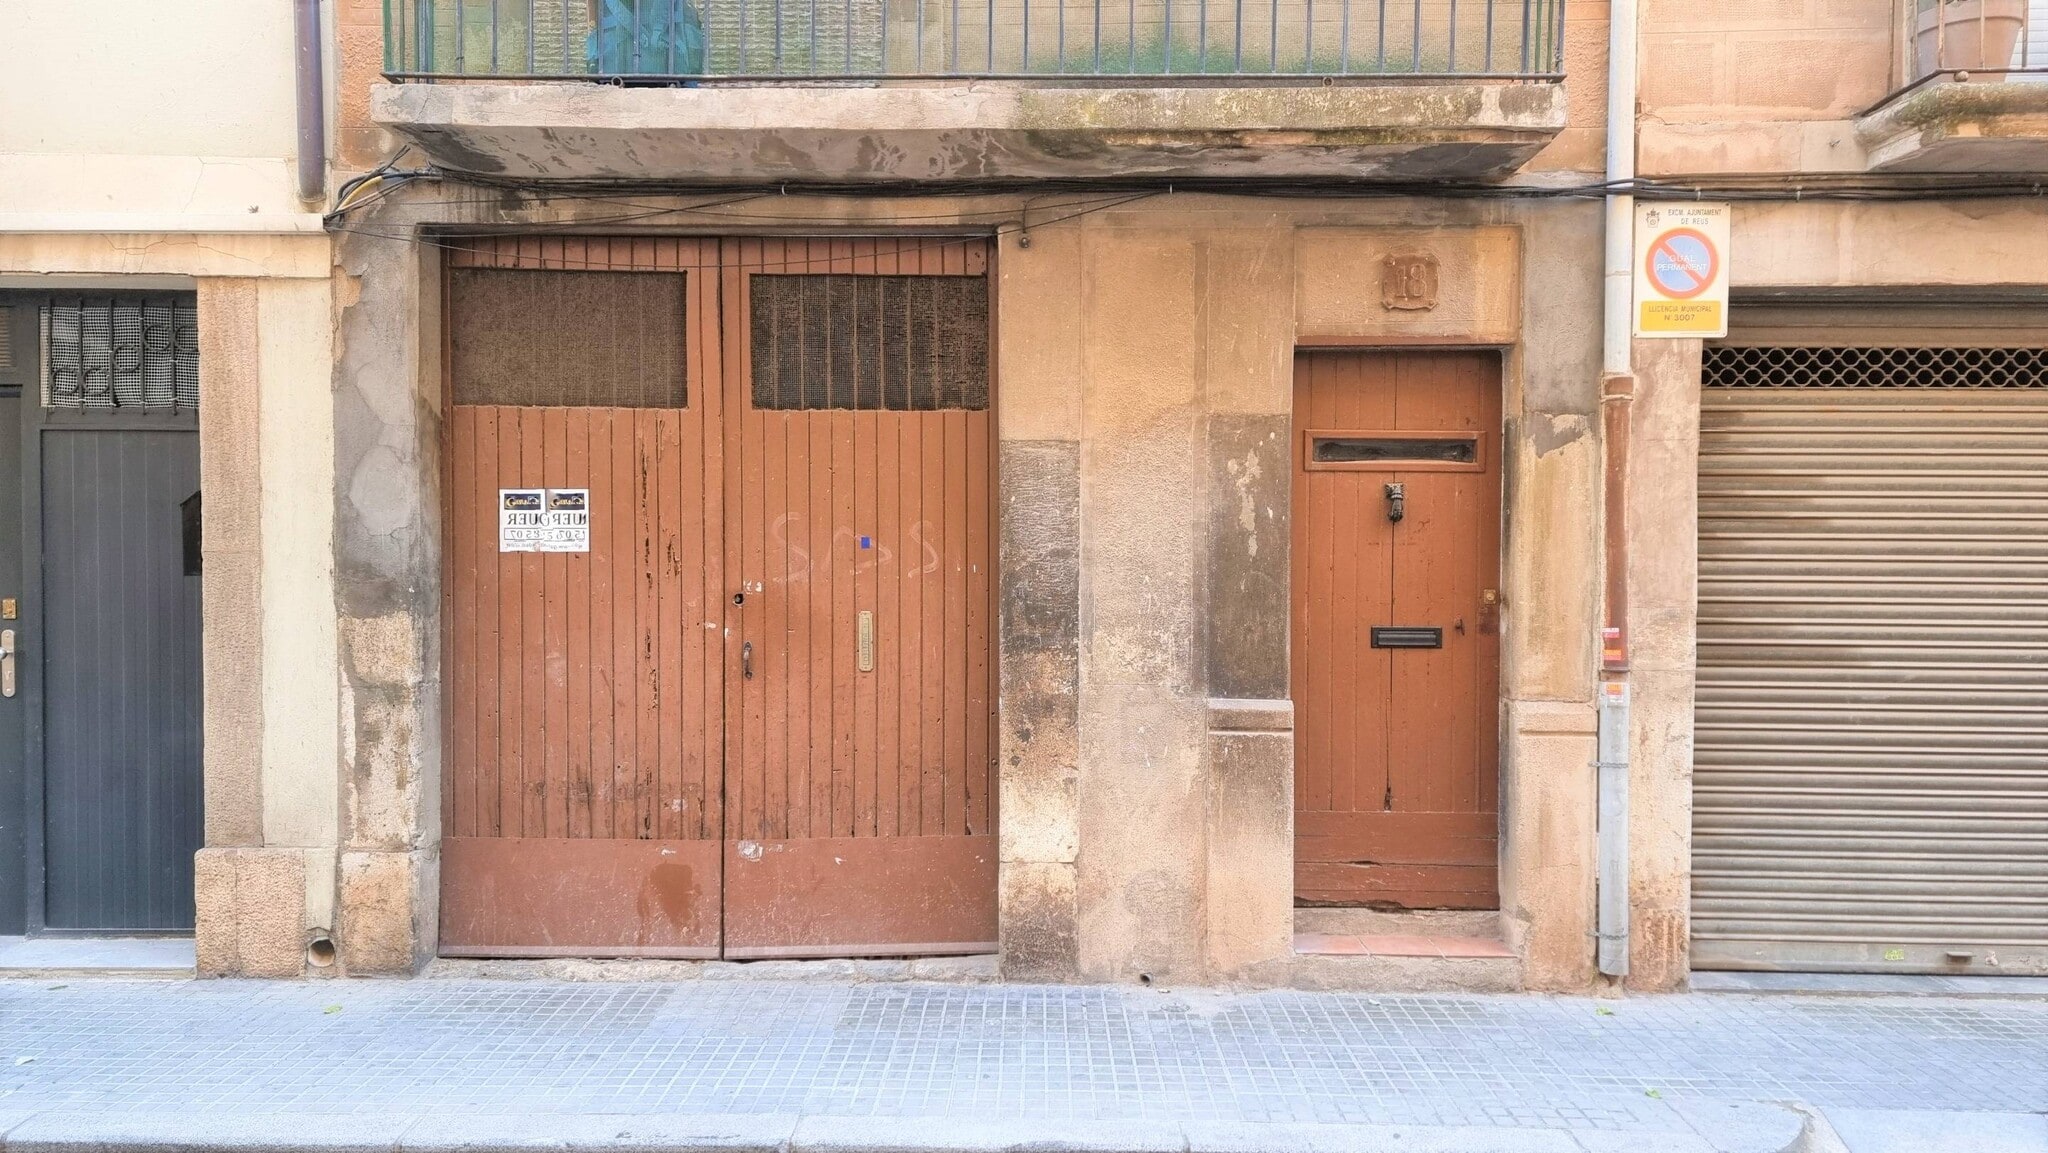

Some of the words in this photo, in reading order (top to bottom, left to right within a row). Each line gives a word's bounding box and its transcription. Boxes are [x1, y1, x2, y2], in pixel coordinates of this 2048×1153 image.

[1657, 263, 1707, 271] PERMANENT
[1395, 263, 1427, 297] 18
[1674, 313, 1696, 321] 3007
